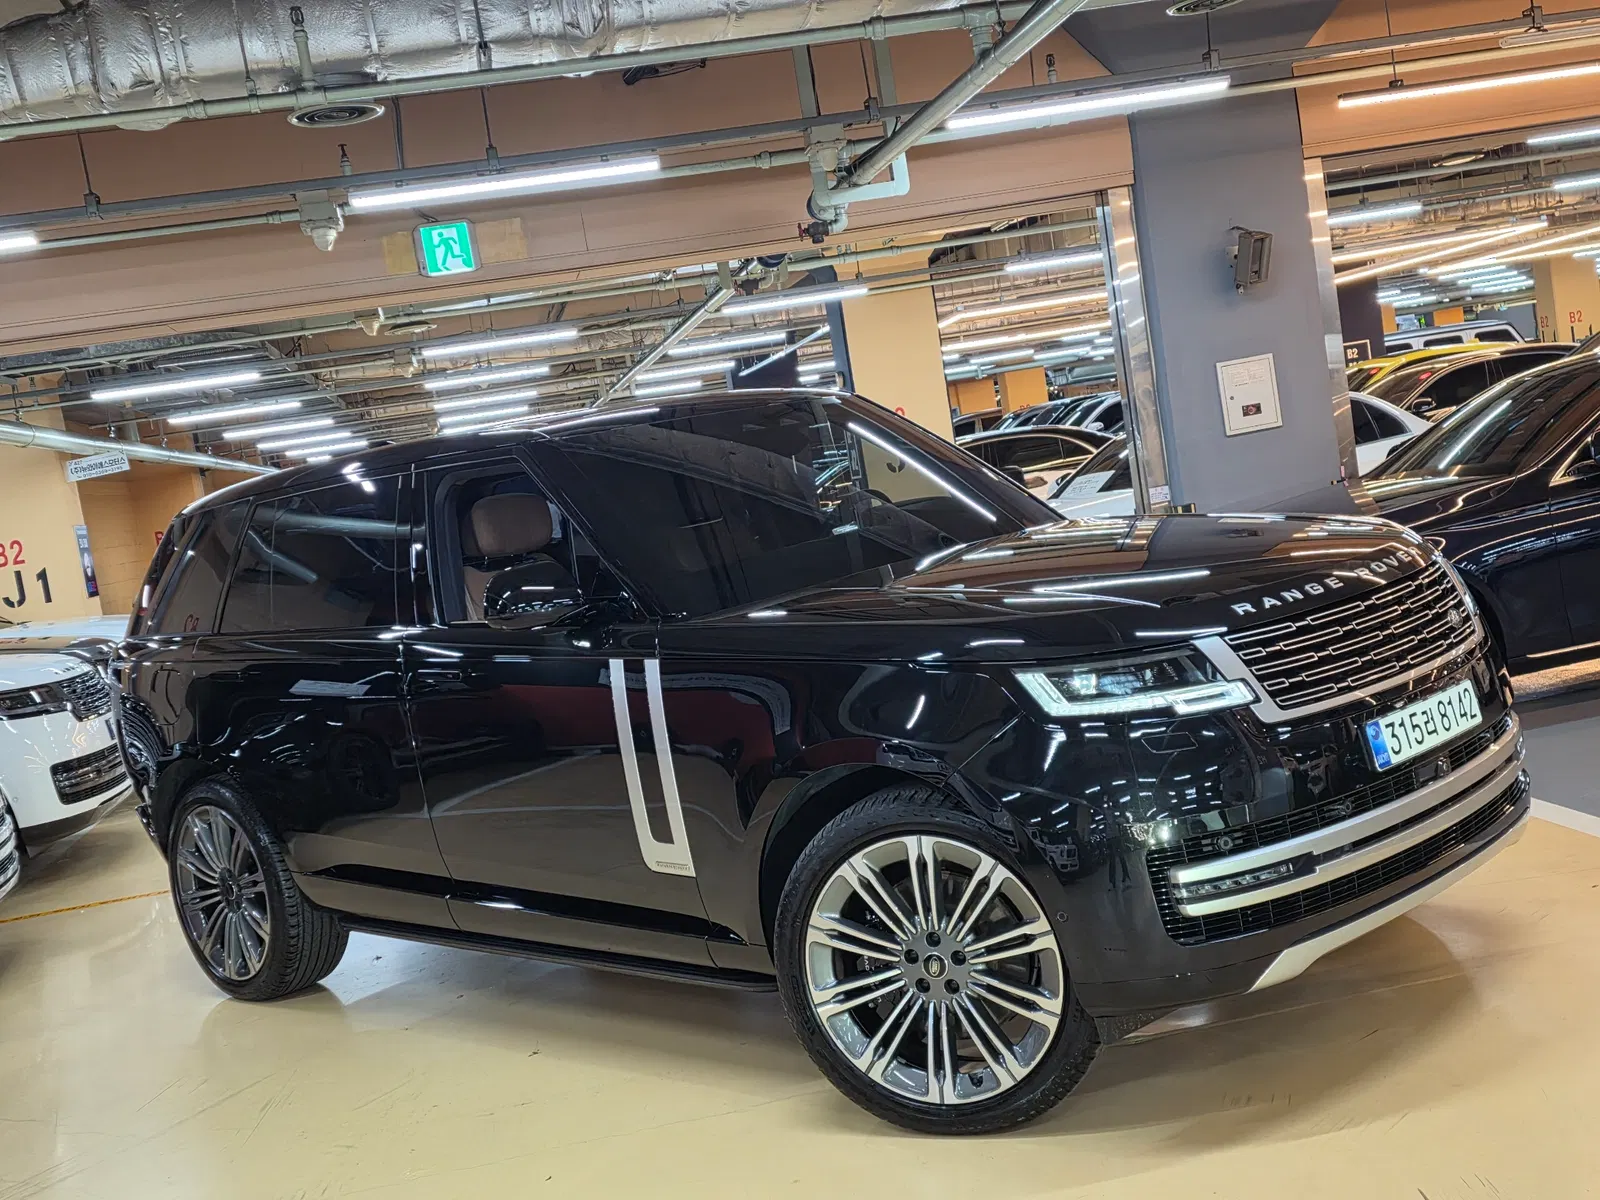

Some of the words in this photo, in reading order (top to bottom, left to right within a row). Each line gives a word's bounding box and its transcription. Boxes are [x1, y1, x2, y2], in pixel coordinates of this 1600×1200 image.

[1540, 316, 1549, 329] B2
[1569, 310, 1583, 324] B2
[1346, 348, 1359, 359] B2
[1230, 576, 1344, 616] RANGE
[1353, 545, 1423, 580] ROVER
